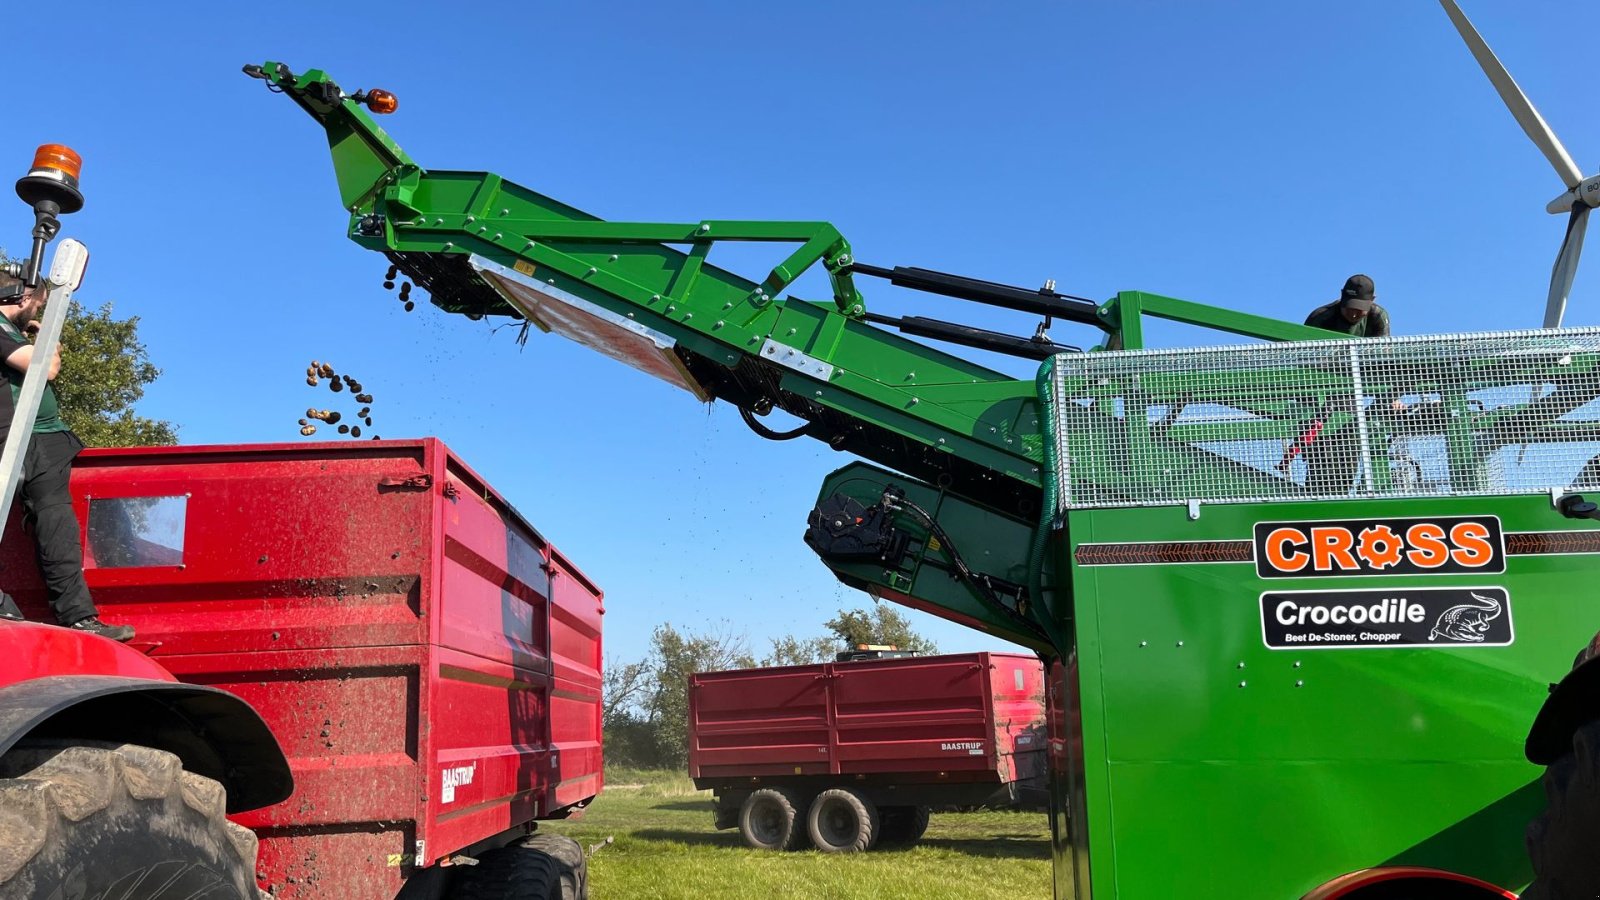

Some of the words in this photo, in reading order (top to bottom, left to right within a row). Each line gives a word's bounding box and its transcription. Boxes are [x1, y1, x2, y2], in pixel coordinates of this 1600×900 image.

[1265, 522, 1493, 572] CROSS
[1275, 598, 1426, 626] Crocodile
[1285, 633, 1307, 642] Beet
[1308, 632, 1358, 642] De-Stoner,
[1359, 632, 1401, 642] Chopper
[941, 742, 982, 750] BAASTRUP
